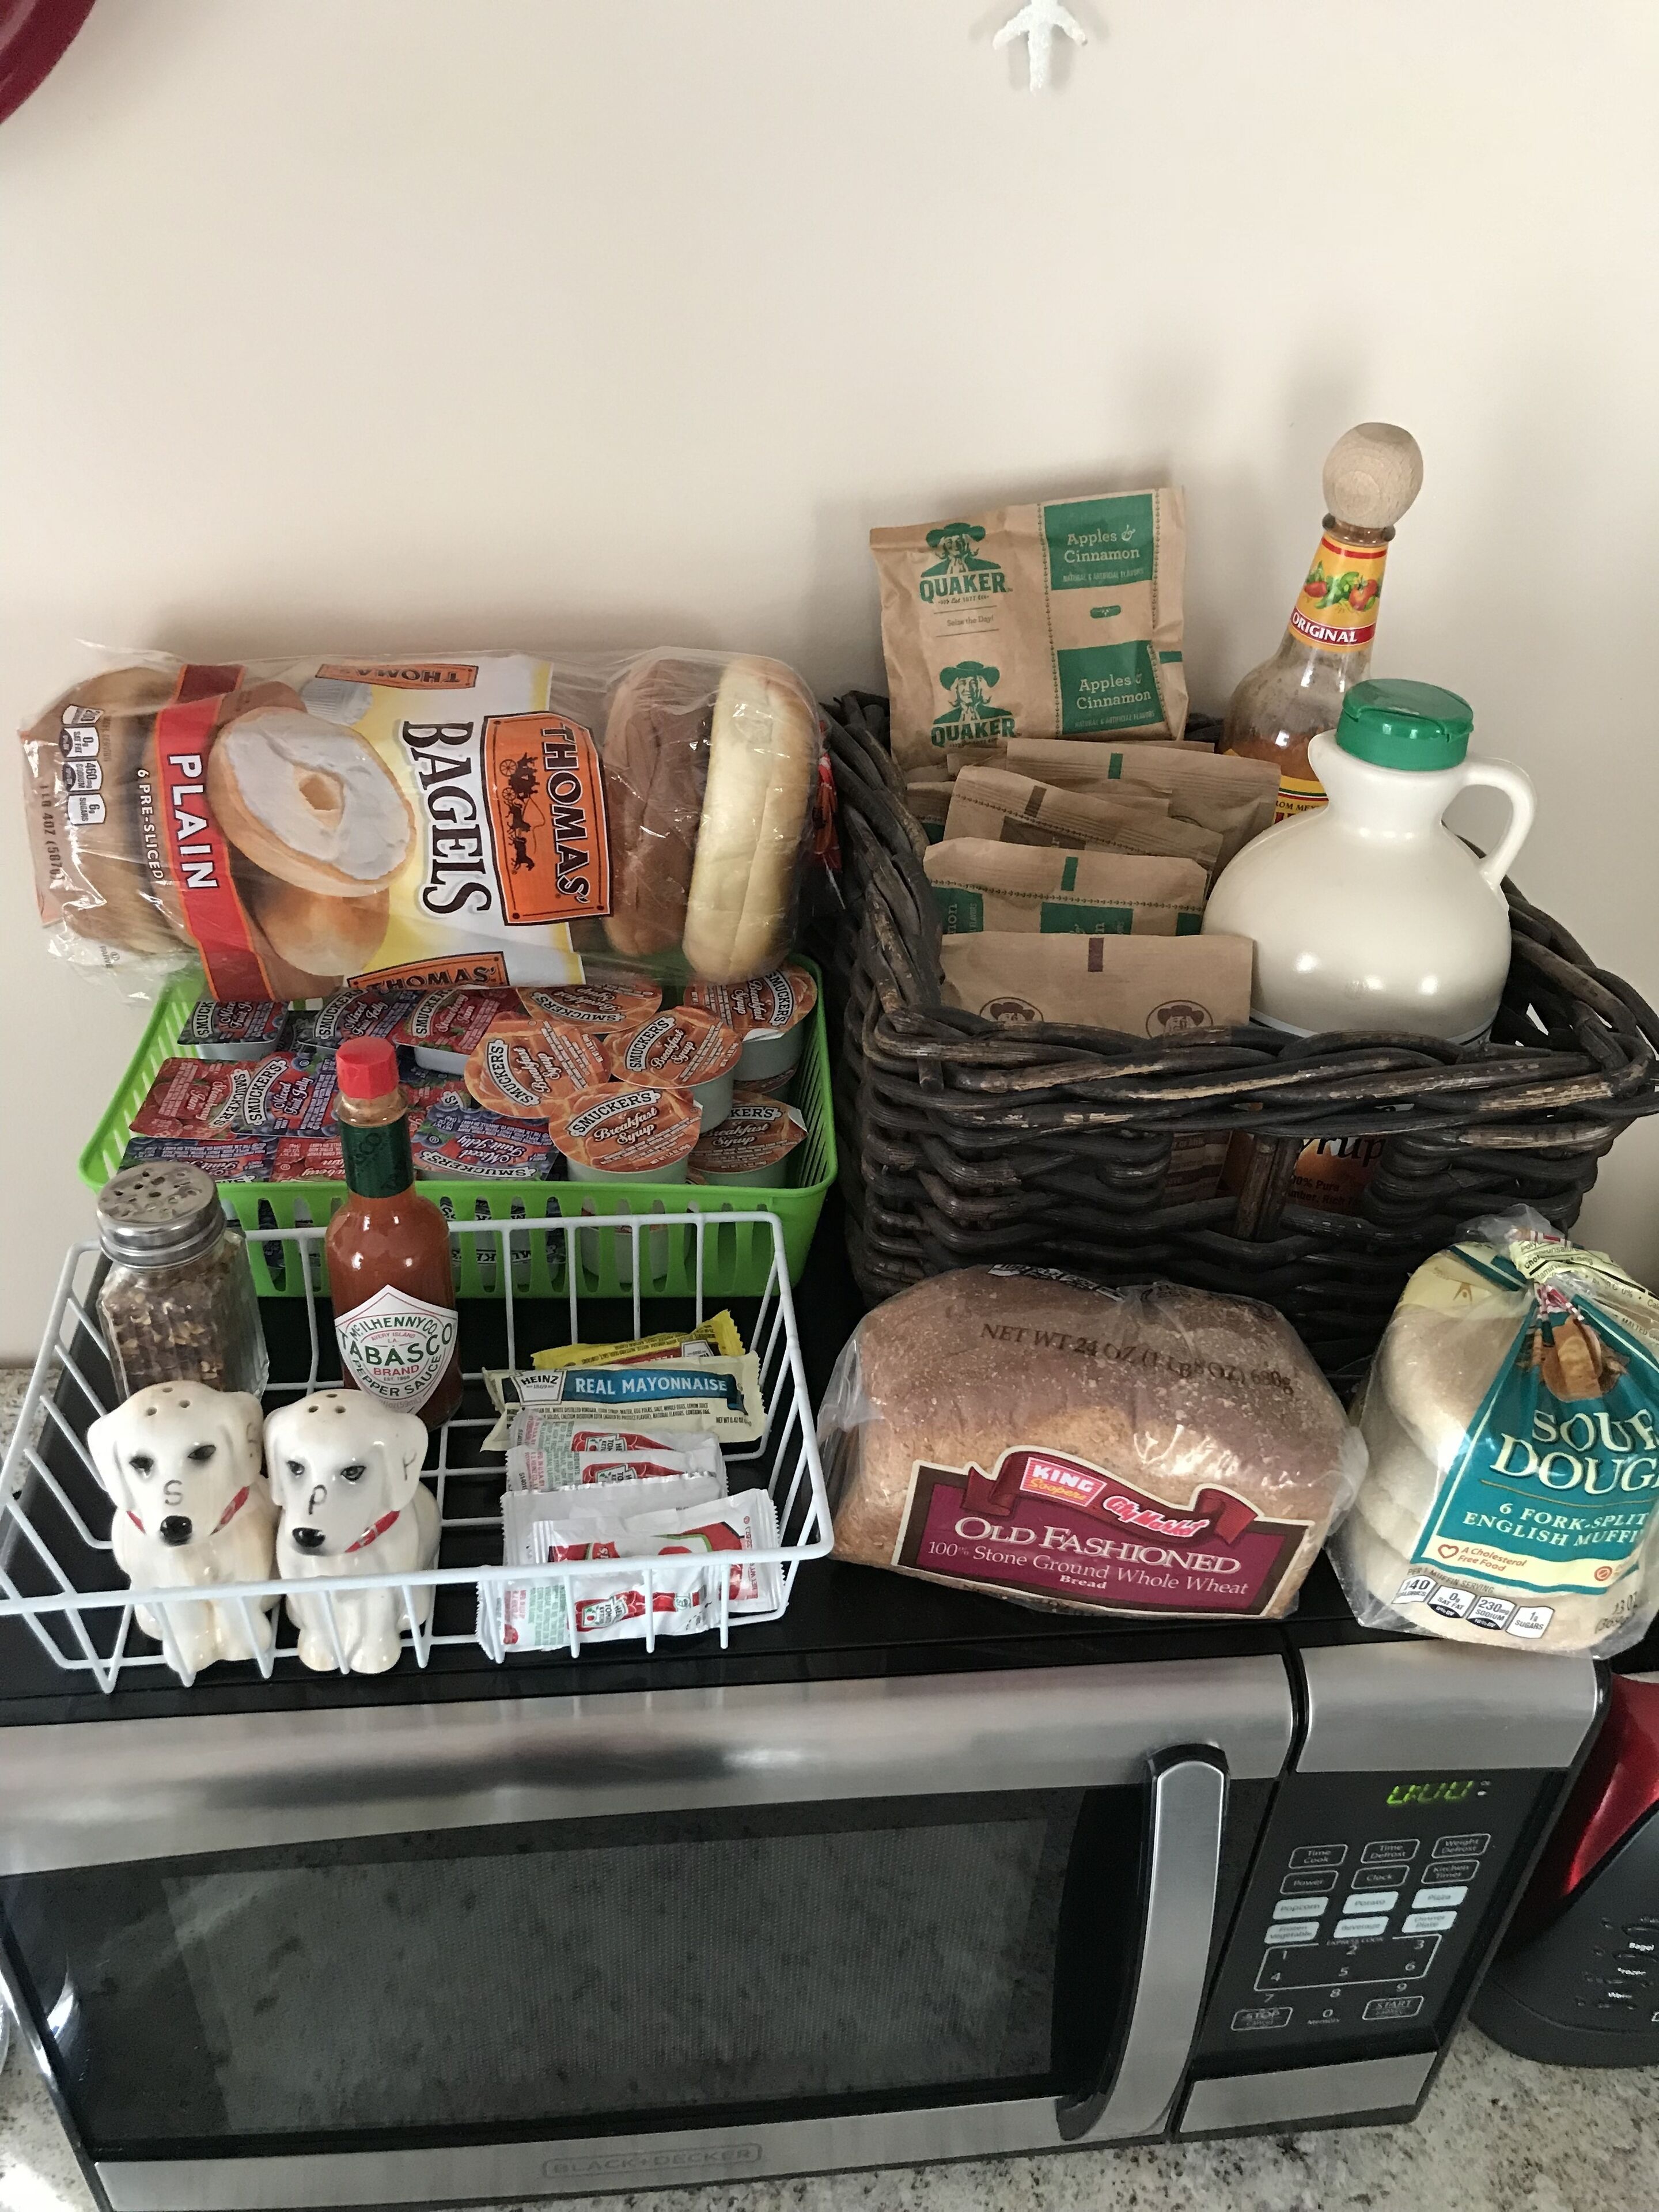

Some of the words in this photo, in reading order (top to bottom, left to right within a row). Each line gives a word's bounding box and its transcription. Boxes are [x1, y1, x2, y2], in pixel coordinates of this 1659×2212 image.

[1067, 528, 1118, 547] Apples
[1064, 548, 1140, 563] Cinnamon
[919, 572, 1006, 604] QUAKER
[1292, 612, 1358, 643] ORIGINAL
[1078, 674, 1132, 694] Apples
[1076, 691, 1152, 710] Cinnamon
[931, 717, 1016, 748] QUAKER
[137, 769, 149, 778] 6
[79, 797, 89, 821] SUGARS
[403, 720, 493, 915] BAGELS
[540, 722, 590, 904] THOMAS'
[138, 784, 164, 879] PRE-SLICED
[169, 753, 219, 889] PLAIN
[555, 990, 618, 1012] Breakfast
[578, 987, 616, 1002] Syrup
[732, 988, 748, 1015] Syrup
[748, 980, 767, 1022] Breakfast
[344, 1001, 368, 1029] Mixed
[367, 1001, 389, 1021] Jelly
[416, 988, 452, 1035] SMUCKER
[435, 994, 469, 1032] Strawberry
[457, 1005, 475, 1024] Jam
[536, 995, 617, 1022] SMUCKER'S
[629, 1018, 670, 1069] SMUCKER'S
[650, 1028, 685, 1069] Breakfast
[671, 1040, 696, 1065] Syrup
[490, 1044, 534, 1104] SMUCKER'S
[513, 1046, 551, 1093] Breakfast
[537, 1052, 562, 1081] Syrup
[186, 1089, 207, 1111] Jam
[195, 1080, 228, 1122] Strawberry
[213, 1073, 247, 1127] SMUCKER'S
[249, 1064, 282, 1124] SMUCKER'S
[274, 1082, 291, 1109] Mixed
[295, 1077, 315, 1103] Jelly
[572, 1090, 653, 1134] SMUCKER'S
[593, 1106, 658, 1142] Breakfast
[617, 1123, 656, 1145] Syrup
[455, 1134, 493, 1151] Jelly
[490, 1139, 525, 1158] Fruit
[713, 1136, 756, 1147] Syrup
[427, 1153, 527, 1177] SMUCKER'S
[459, 1149, 510, 1164] Mixed
[338, 1322, 453, 1366] TABASCO
[370, 1332, 390, 1342] AVERY
[979, 1323, 1029, 1343] NET
[1033, 1330, 1073, 1350] WT
[1072, 1336, 1099, 1357] 24
[1103, 1342, 1138, 1364] OZ
[1167, 1355, 1192, 1378] LB
[1194, 1357, 1205, 1374] 8
[352, 1359, 400, 1396] PEPPER
[404, 1354, 442, 1395] SAUCE
[373, 1365, 420, 1376] BRAND
[521, 1374, 559, 1385] HEINZ
[575, 1378, 616, 1395] REAL
[622, 1376, 728, 1395] MAYONNAISE
[1490, 1431, 1659, 1495] DOUG
[1029, 1478, 1090, 1501] Soopers
[1032, 1464, 1094, 1493] KING
[164, 1479, 184, 1506] S
[308, 1483, 328, 1516] P
[1499, 1502, 1513, 1516] 6
[1522, 1507, 1650, 1532] FORK-SPLIT
[1463, 1512, 1569, 1546] ENGLISH
[955, 1516, 1037, 1546] OLD
[1038, 1525, 1242, 1575] FASHIONED
[1461, 1546, 1469, 1554] A
[927, 1541, 969, 1556] 100%
[973, 1546, 1028, 1567] Stone
[1033, 1554, 1110, 1580] Ground
[1116, 1567, 1180, 1589] Whole
[1186, 1575, 1249, 1595] Wheat
[1457, 1555, 1479, 1565] Free
[1479, 1559, 1508, 1572] Food
[1059, 1574, 1108, 1590] Bread
[1403, 1579, 1431, 1592] 140
[1429, 1569, 1460, 1586] MUFFIN
[1460, 1580, 1495, 1594] SERVING
[1437, 1597, 1451, 1606] SAT
[1450, 1601, 1465, 1611] FAT
[1449, 1592, 1461, 1603] 0g
[1478, 1599, 1511, 1616] 230mg
[1475, 1608, 1506, 1622] SODIUM
[1514, 1619, 1544, 1631] SUGARS
[1370, 1851, 1406, 1859] Defrost
[1366, 1874, 1393, 1882] Clock
[1280, 1903, 1320, 1915] Popcorn
[1282, 1950, 1288, 1960] 1
[1346, 1945, 1358, 1956] 2
[1414, 1940, 1425, 1950] 3
[1338, 1967, 1349, 1977] 5
[1404, 1960, 1416, 1971] 6
[1271, 1972, 1282, 1982] 4
[1396, 1983, 1408, 1992] 9
[1264, 1993, 1275, 2003] 7
[1330, 1988, 1341, 1998] 8
[1377, 1999, 1412, 2009] START
[1246, 2008, 1281, 2019] STOP
[1322, 2009, 1334, 2018] 0
[552, 2149, 751, 2175] BLACK+DECKER
